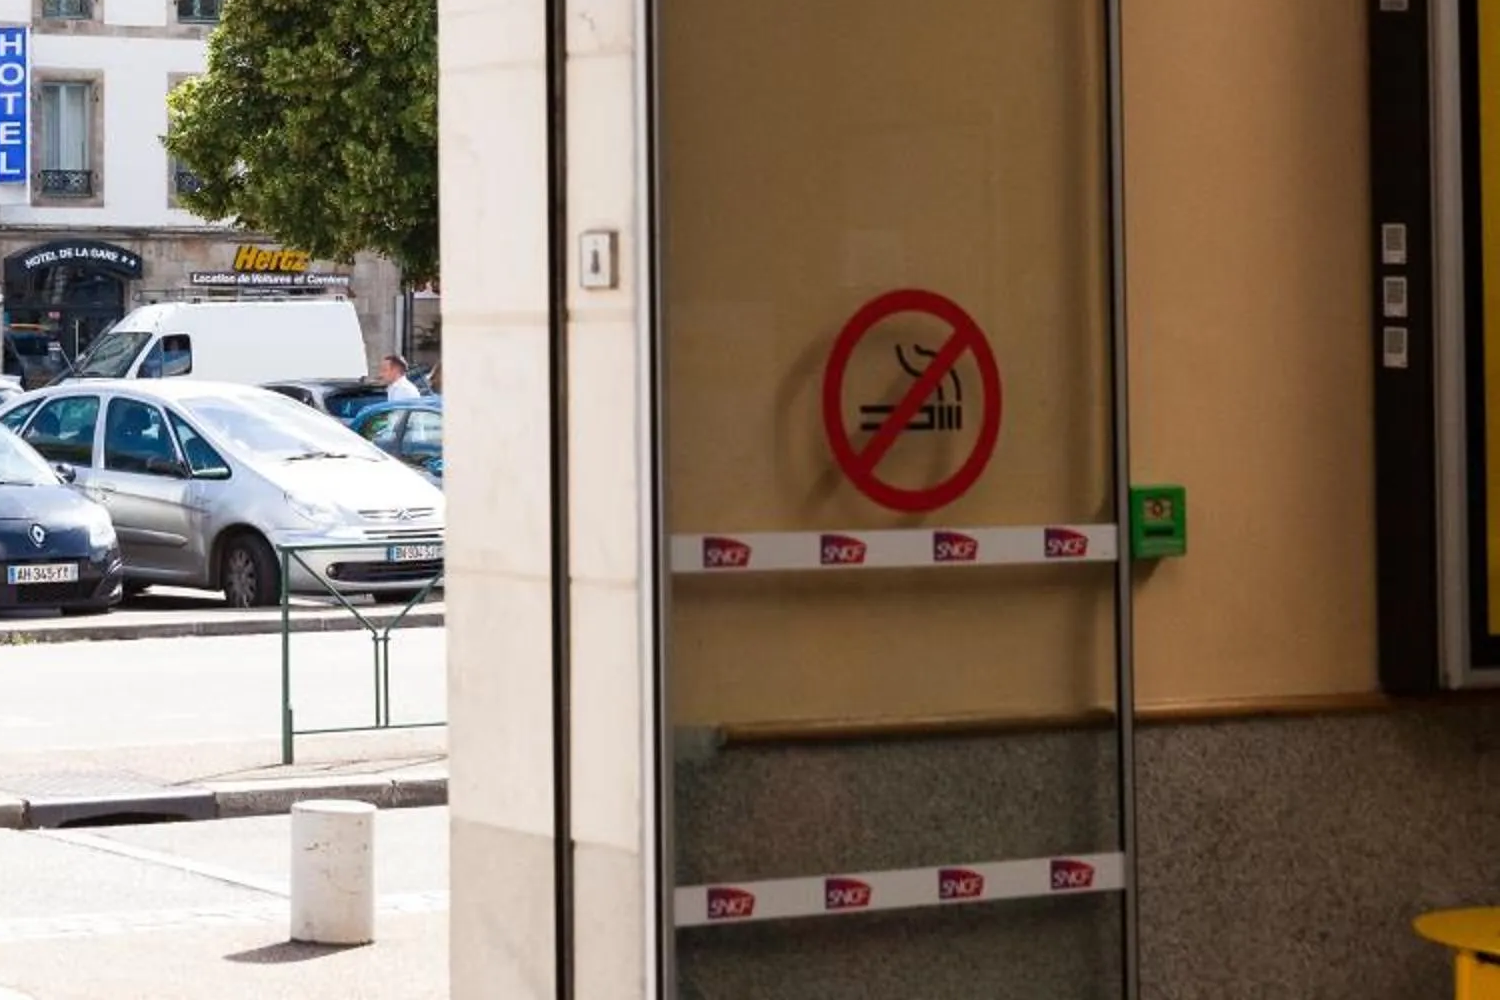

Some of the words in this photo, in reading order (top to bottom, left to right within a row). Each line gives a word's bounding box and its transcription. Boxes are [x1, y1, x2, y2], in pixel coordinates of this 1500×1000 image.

[59, 247, 73, 259] DE
[75, 247, 89, 257] LA
[234, 245, 311, 272] Hertz
[706, 548, 748, 566] SNCF
[823, 544, 865, 563] SNCF
[936, 541, 976, 560] SNCF
[1047, 538, 1087, 557] SNCF
[1053, 869, 1093, 888] SNCF
[828, 888, 869, 907] SNCF
[942, 879, 982, 898] SNCF
[710, 898, 751, 917] SNCF
